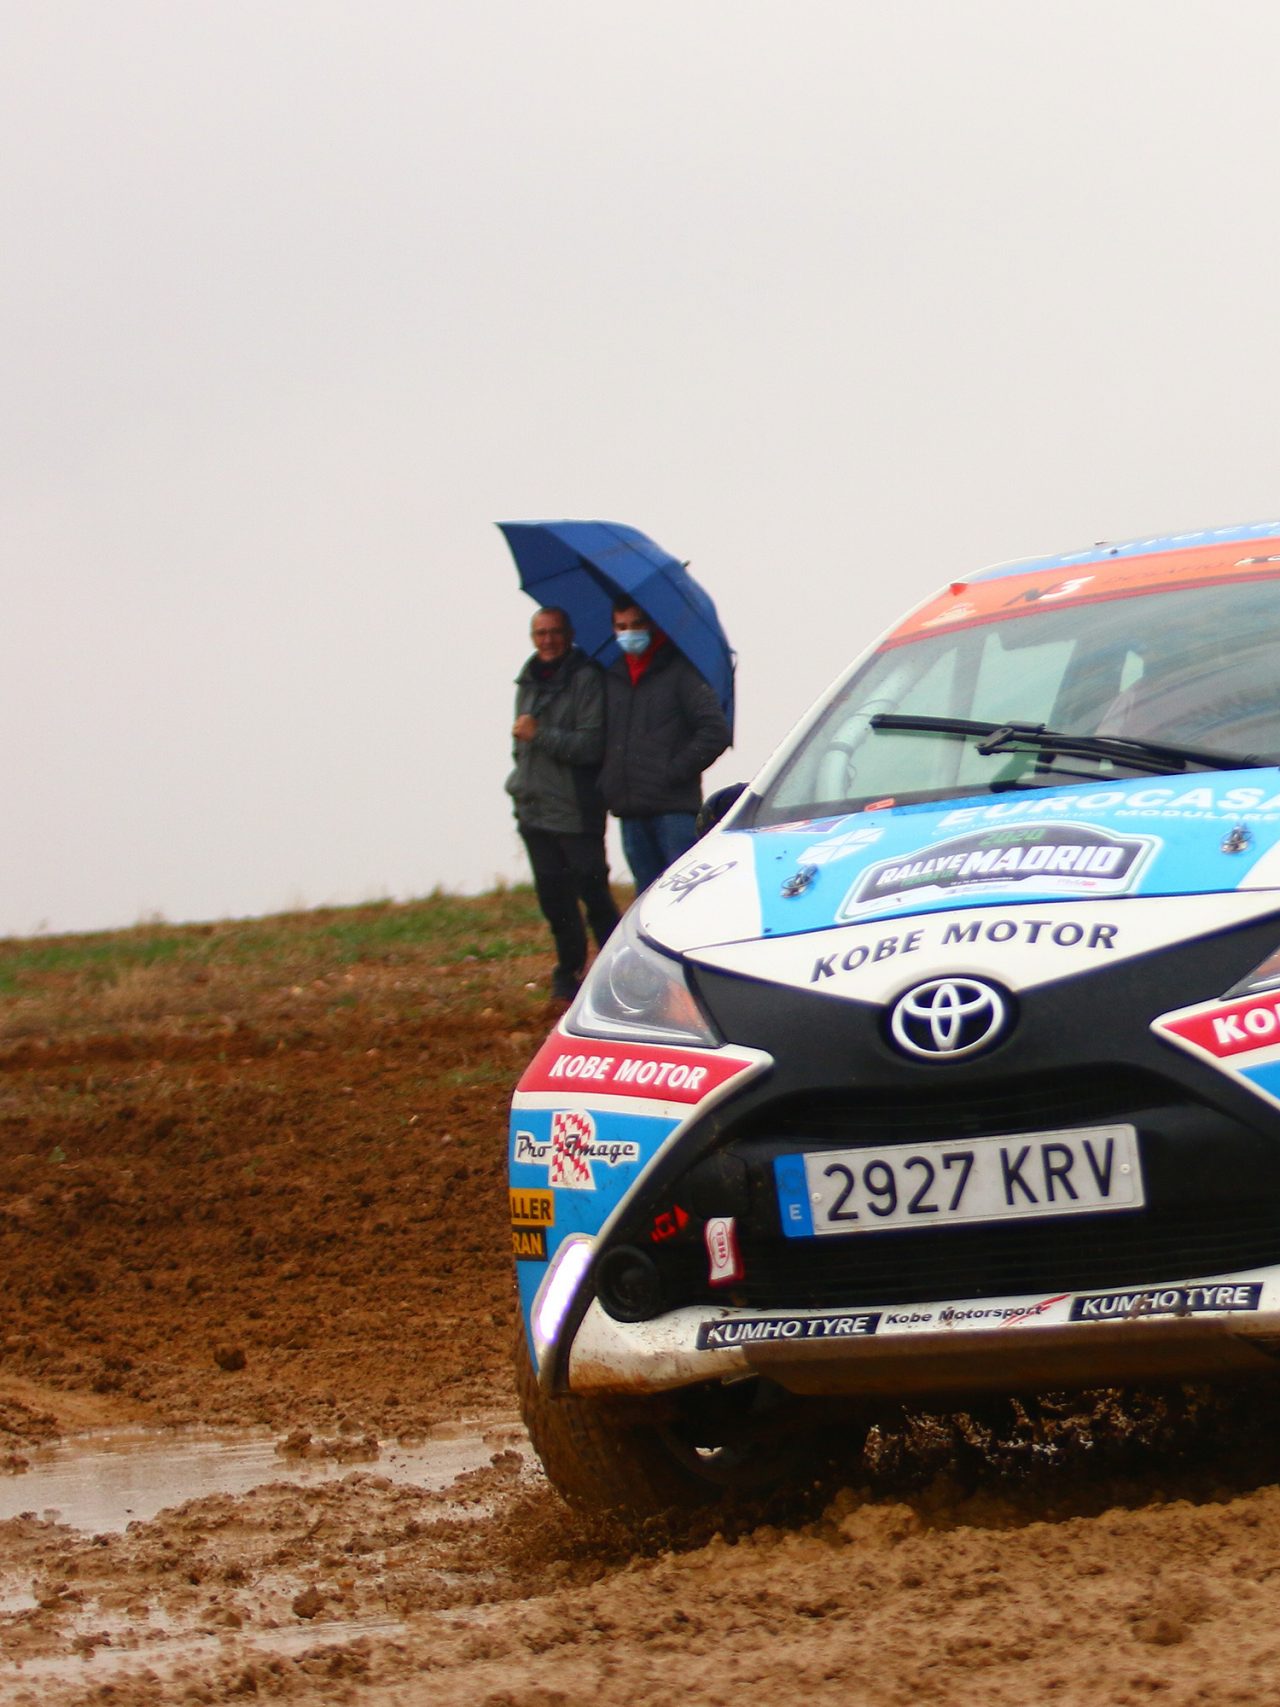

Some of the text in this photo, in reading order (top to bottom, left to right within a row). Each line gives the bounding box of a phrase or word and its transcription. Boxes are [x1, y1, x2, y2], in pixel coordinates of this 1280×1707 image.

[978, 827, 1048, 847] 2020
[876, 852, 968, 887] RALLYE
[958, 845, 1125, 876] MADRID
[808, 920, 1119, 982] KOBE MOTOR
[549, 1054, 709, 1090] KOBE MOTOR
[517, 1135, 552, 1159] Pro
[822, 1137, 1115, 1222] 2927 KRV
[788, 1203, 802, 1220] E
[886, 1304, 1044, 1326] Kobe Motorsport
[1080, 1286, 1250, 1316] KUMHO TYRE
[705, 1316, 870, 1344] KUMHO TYRE
